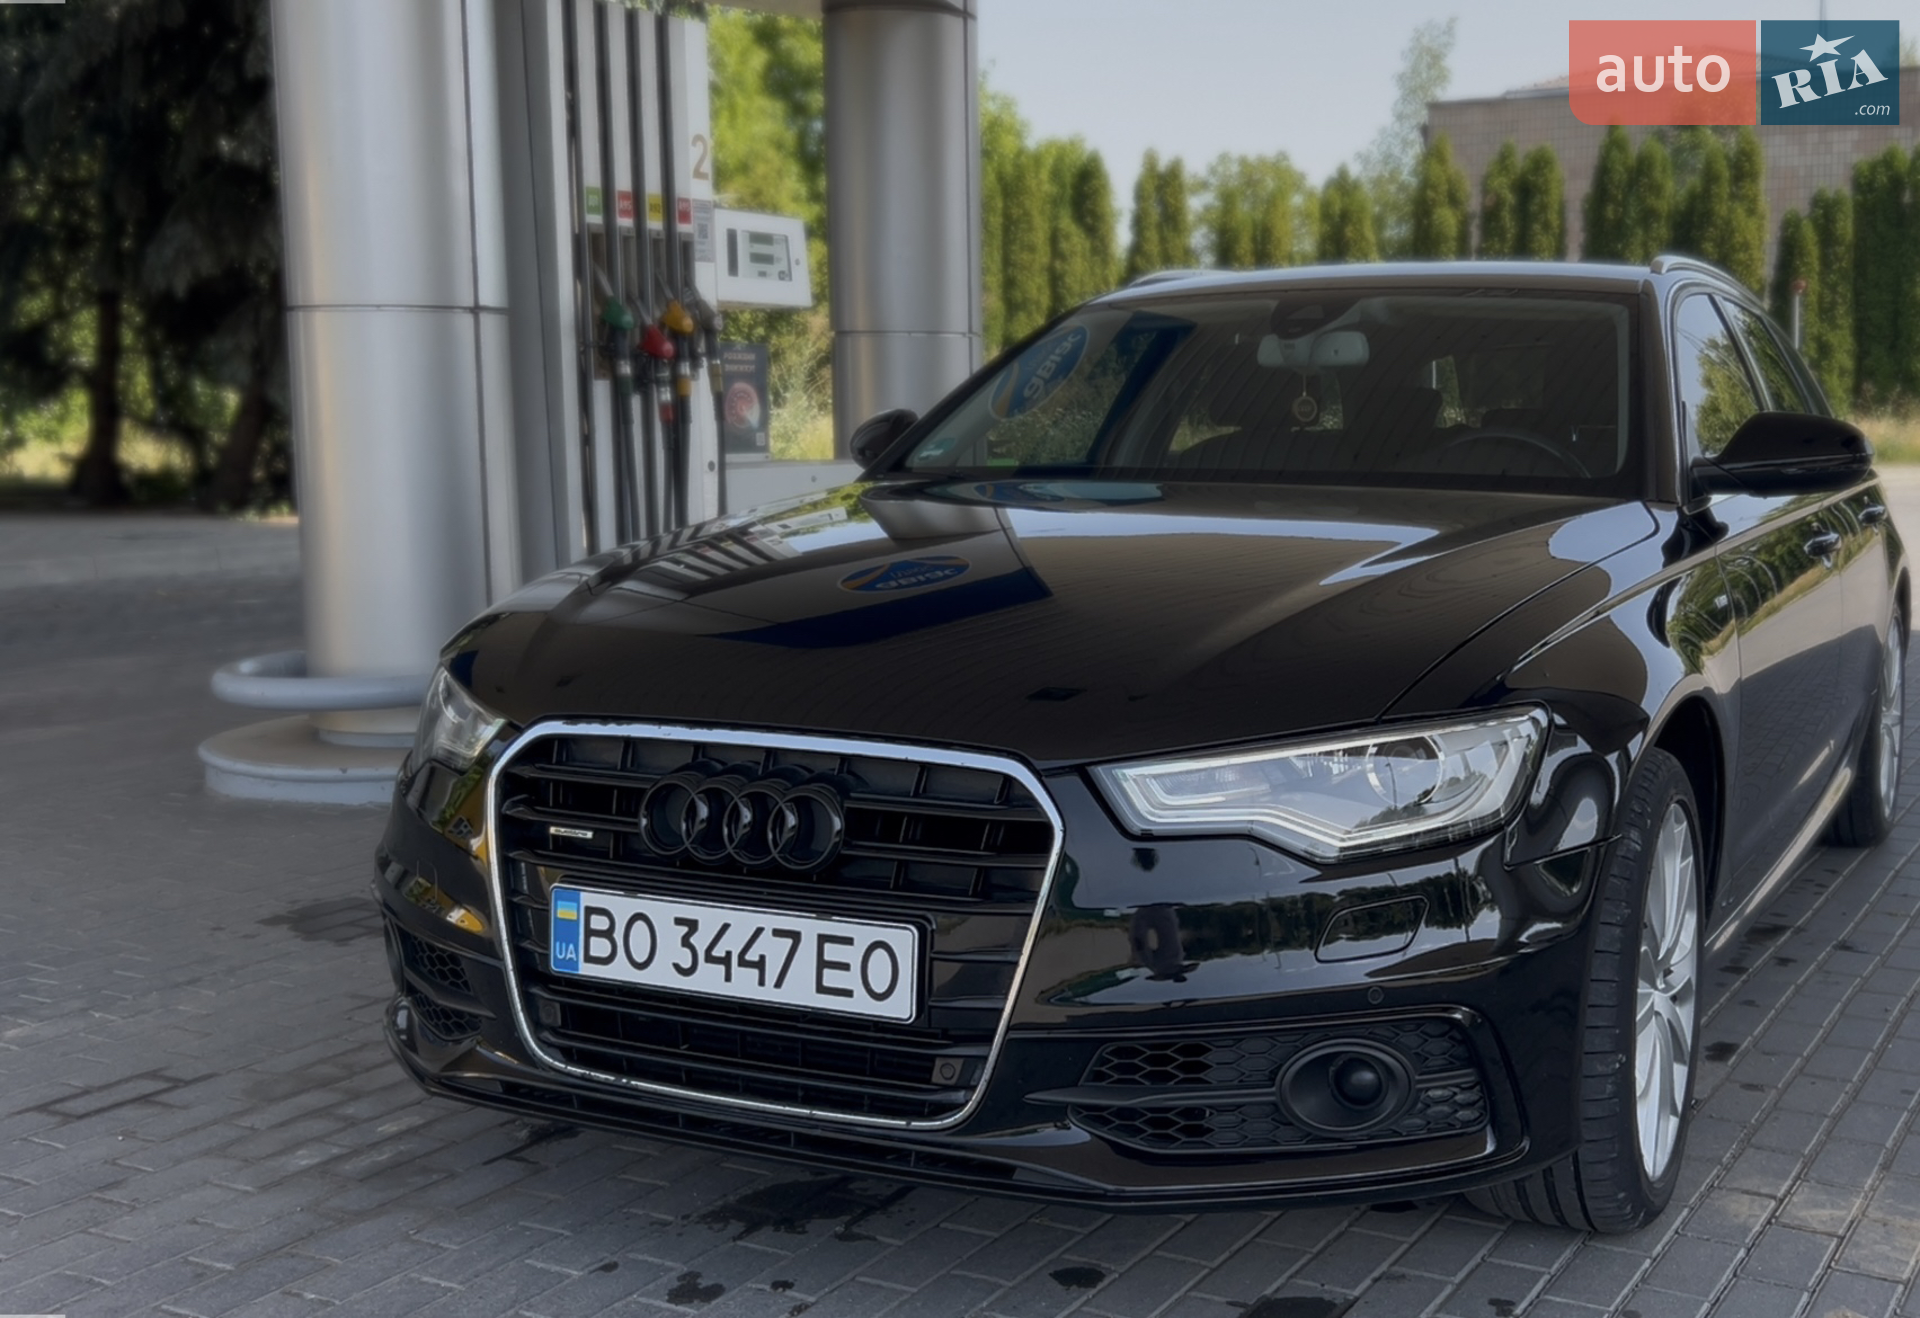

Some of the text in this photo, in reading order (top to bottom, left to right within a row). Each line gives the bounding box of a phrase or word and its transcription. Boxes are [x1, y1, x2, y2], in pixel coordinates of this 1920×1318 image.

[691, 134, 709, 180] 2
[555, 942, 577, 961] UA
[583, 905, 899, 1002] BO 3447 EO
